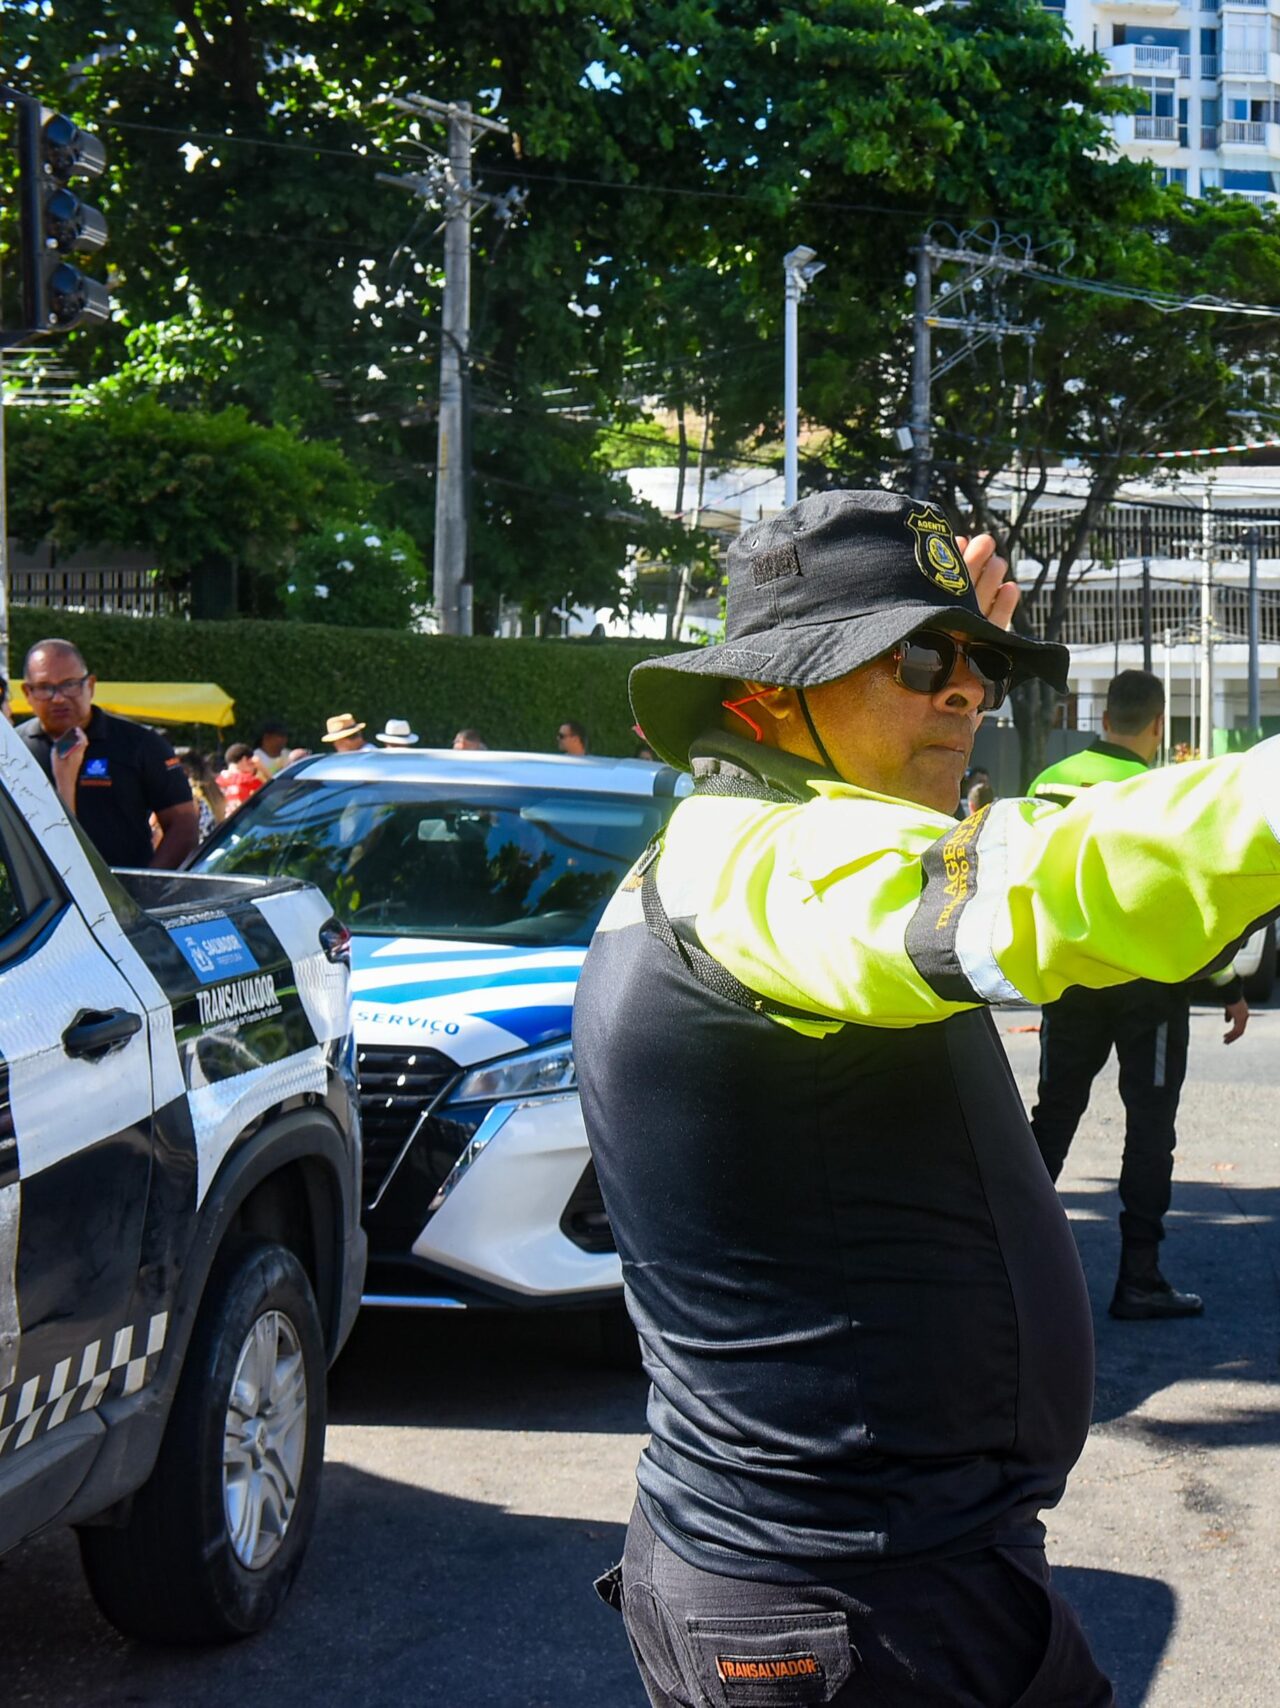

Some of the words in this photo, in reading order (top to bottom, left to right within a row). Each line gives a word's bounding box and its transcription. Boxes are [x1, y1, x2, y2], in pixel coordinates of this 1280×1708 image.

[917, 520, 947, 533] AGENTE
[202, 934, 243, 957] SALVADOR
[196, 974, 280, 1026] TRANSALVADOR
[357, 1011, 460, 1036] SERVIÇO
[721, 1658, 816, 1679] TRANSALVADOR
